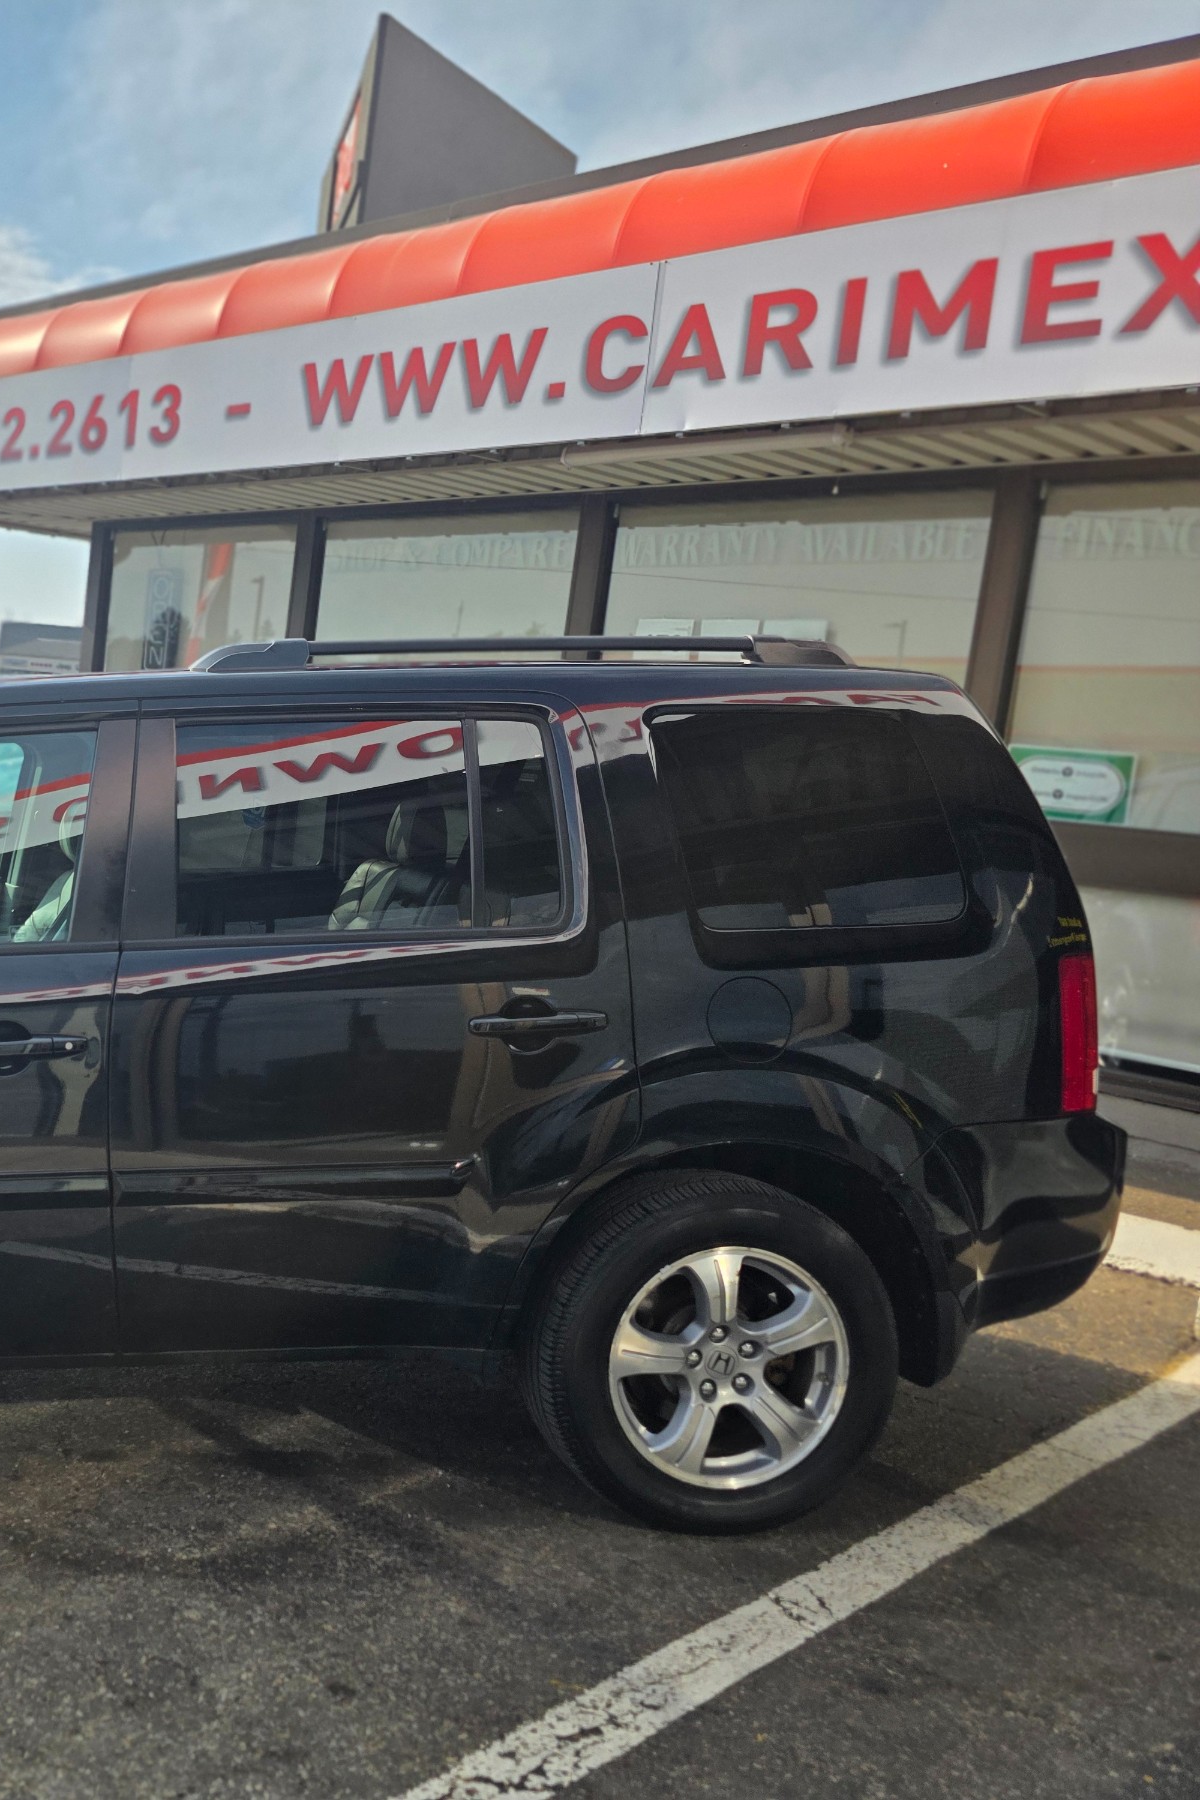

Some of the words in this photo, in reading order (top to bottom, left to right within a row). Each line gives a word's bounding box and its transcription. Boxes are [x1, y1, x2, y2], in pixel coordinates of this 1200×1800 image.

[303, 232, 1200, 427] WWW.CARIMEX
[432, 535, 572, 569] COMPARE
[617, 527, 779, 567] WARRANTY
[800, 520, 977, 562] AVAILABLE
